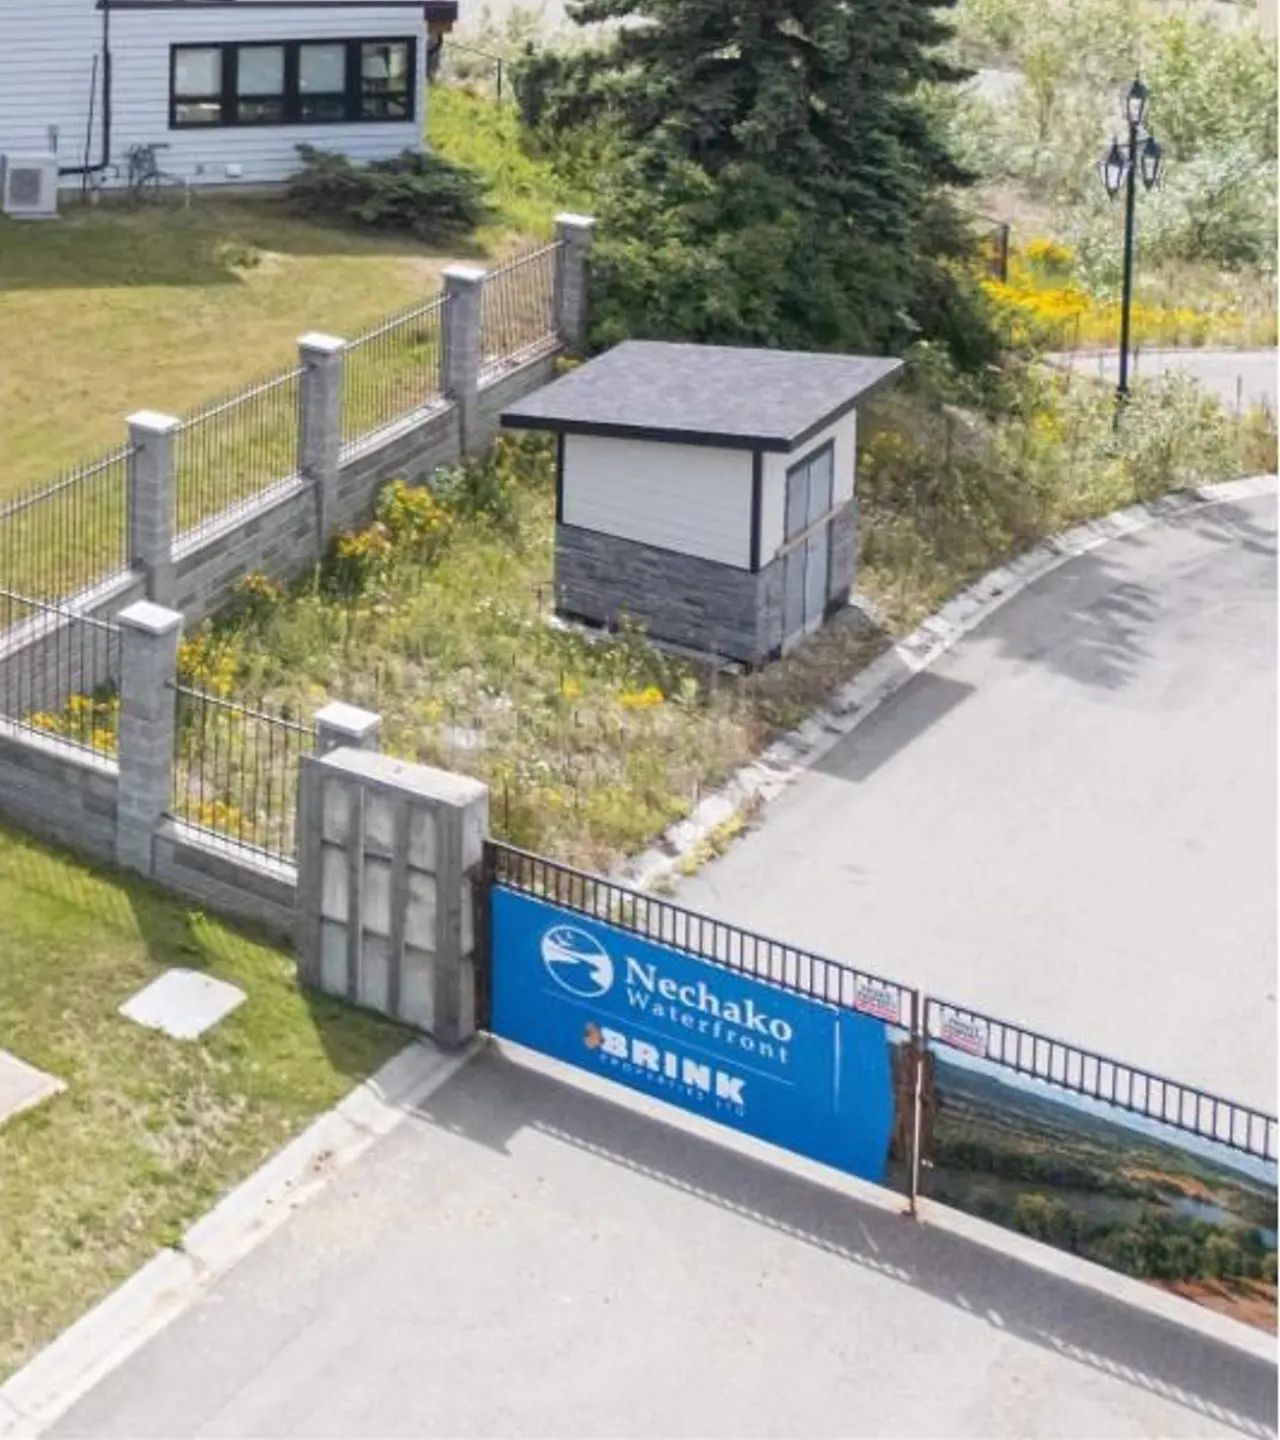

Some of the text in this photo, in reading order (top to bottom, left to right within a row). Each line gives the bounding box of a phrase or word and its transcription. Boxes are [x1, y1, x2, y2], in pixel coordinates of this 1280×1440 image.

[624, 956, 792, 1042] Nechako
[626, 988, 790, 1064] Waterfront
[600, 1026, 747, 1105] BRINK
